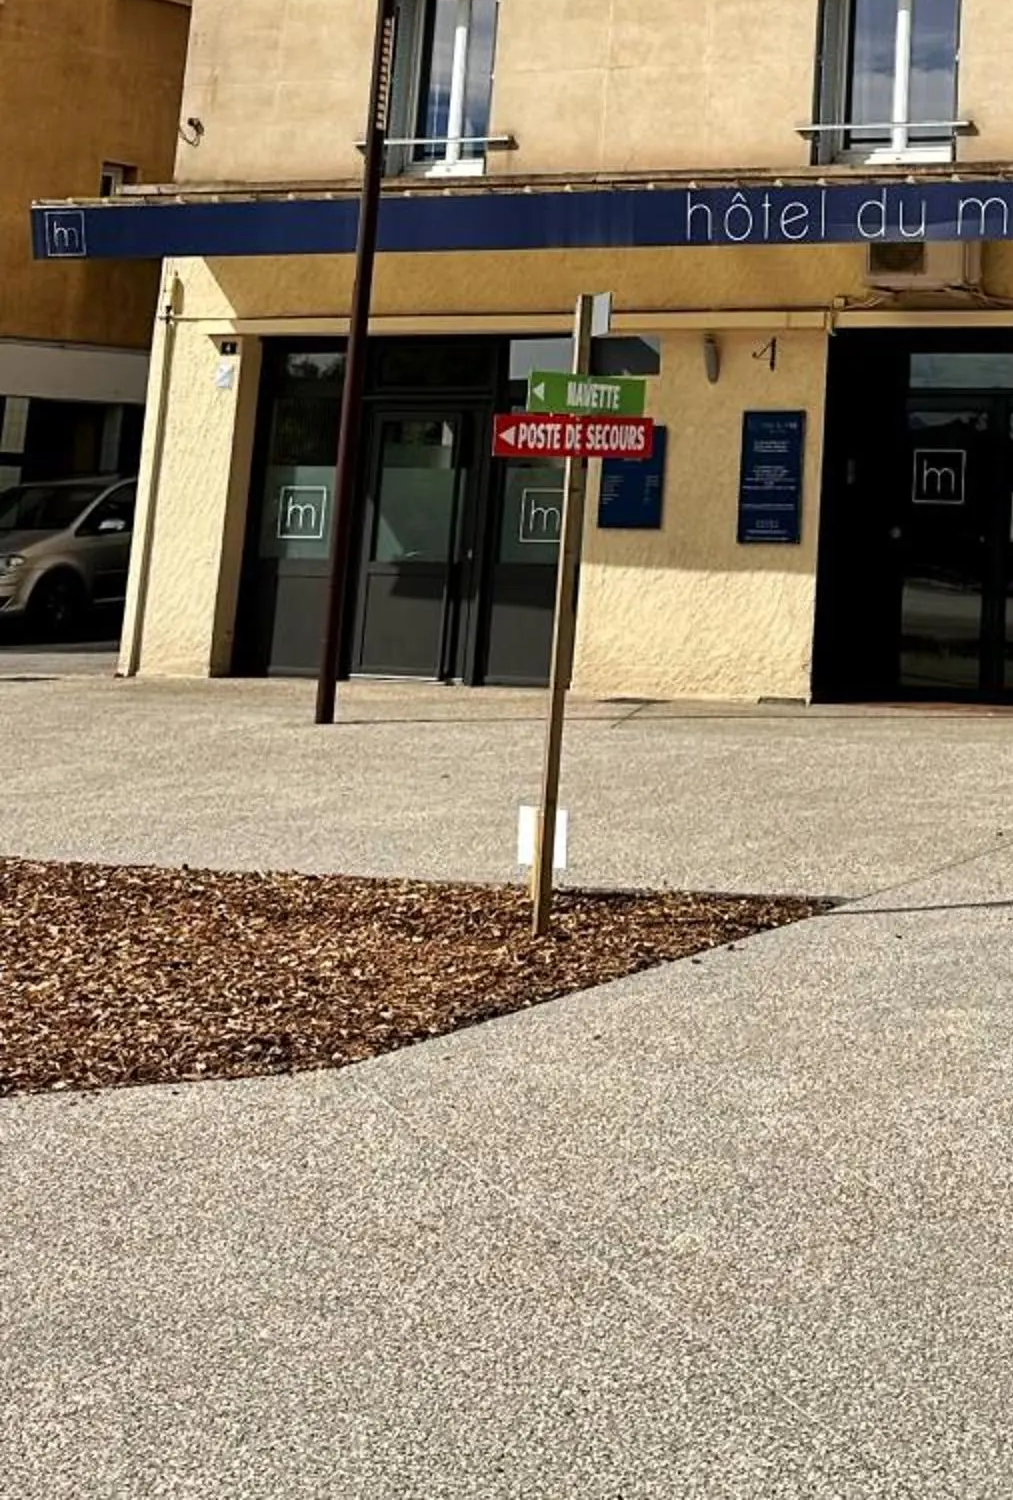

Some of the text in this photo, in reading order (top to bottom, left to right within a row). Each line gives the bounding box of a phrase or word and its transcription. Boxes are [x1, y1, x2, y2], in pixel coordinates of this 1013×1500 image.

[686, 189, 826, 241] hôtel
[857, 187, 926, 238] du
[566, 381, 621, 410] NAVETTE
[517, 423, 645, 451] POSTE DE SECOURS
